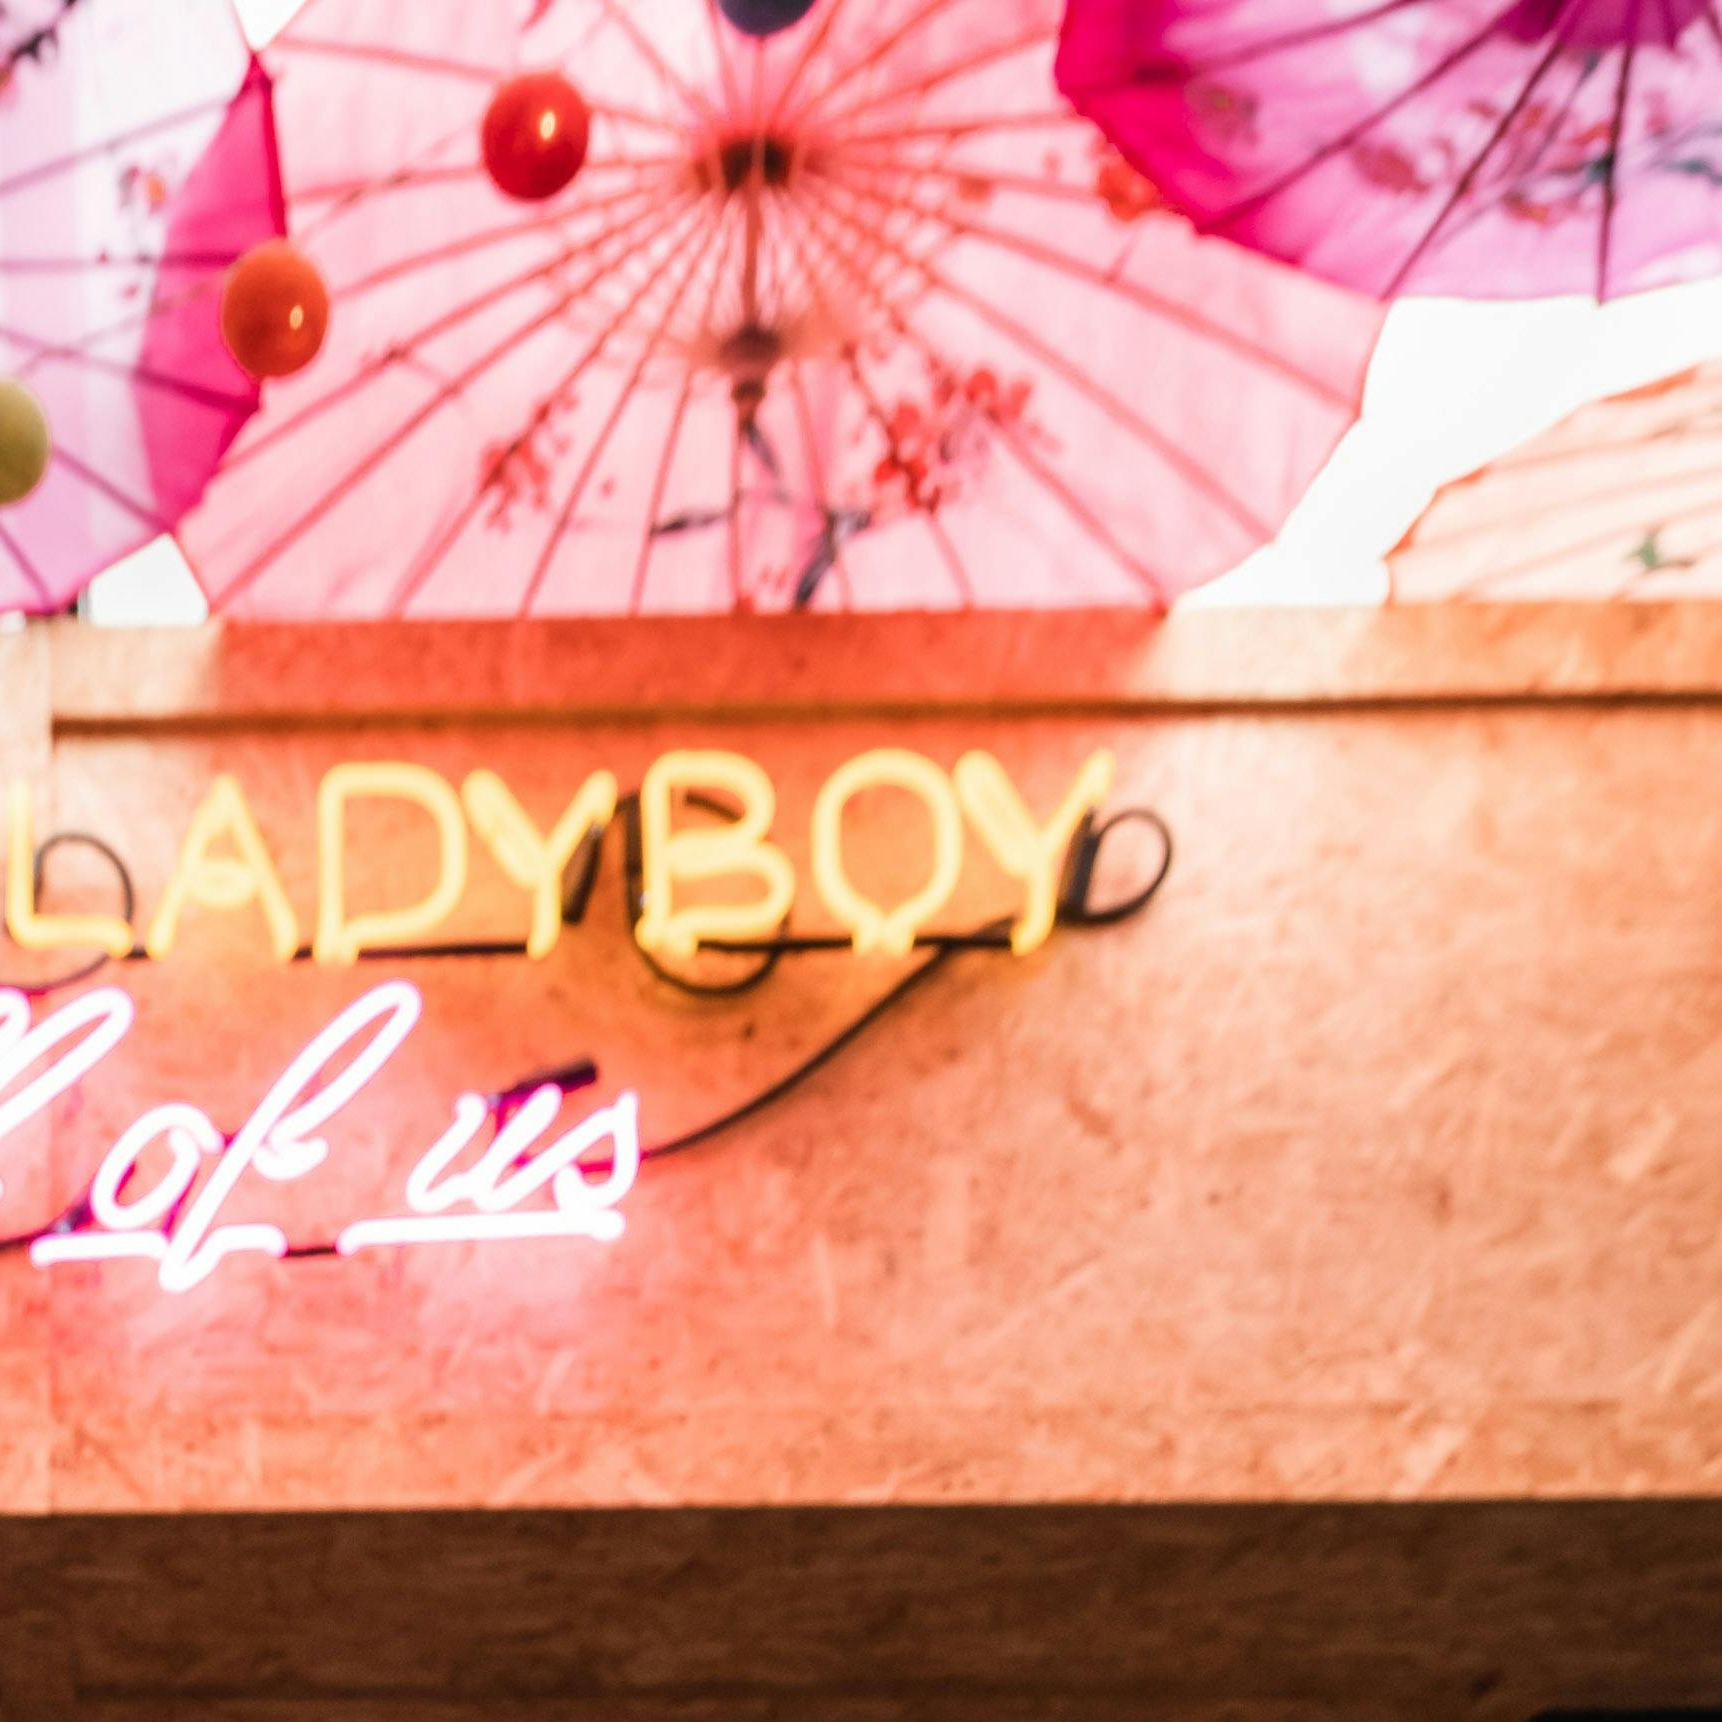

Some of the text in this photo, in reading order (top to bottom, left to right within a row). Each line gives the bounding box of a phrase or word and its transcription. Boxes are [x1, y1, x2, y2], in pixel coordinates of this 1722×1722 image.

[4, 748, 1116, 964] LADYBOY
[88, 978, 422, 1294] of
[405, 1082, 641, 1214] us
